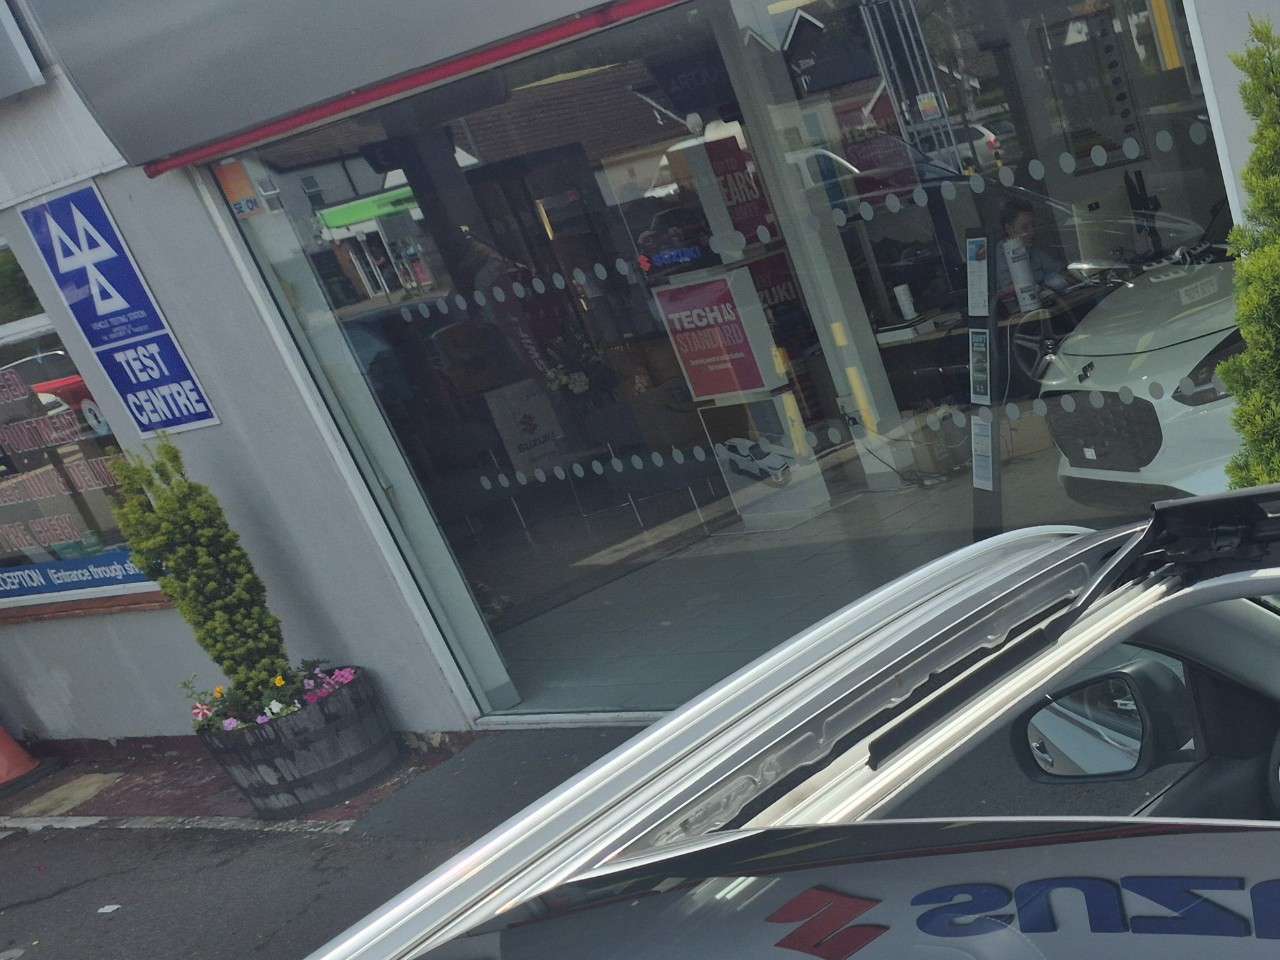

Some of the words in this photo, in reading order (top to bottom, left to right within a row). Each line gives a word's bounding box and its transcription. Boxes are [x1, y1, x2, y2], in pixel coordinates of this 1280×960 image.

[720, 170, 760, 206] EARS
[759, 281, 799, 305] ZUKI
[667, 305, 722, 331] TECH
[721, 303, 736, 321] AS
[676, 322, 744, 353] STANDARD
[113, 342, 170, 384] TEST
[126, 379, 208, 425] CENTRE
[0, 568, 46, 592] CEPTION
[47, 567, 92, 586] (Entrance
[88, 561, 126, 580] through
